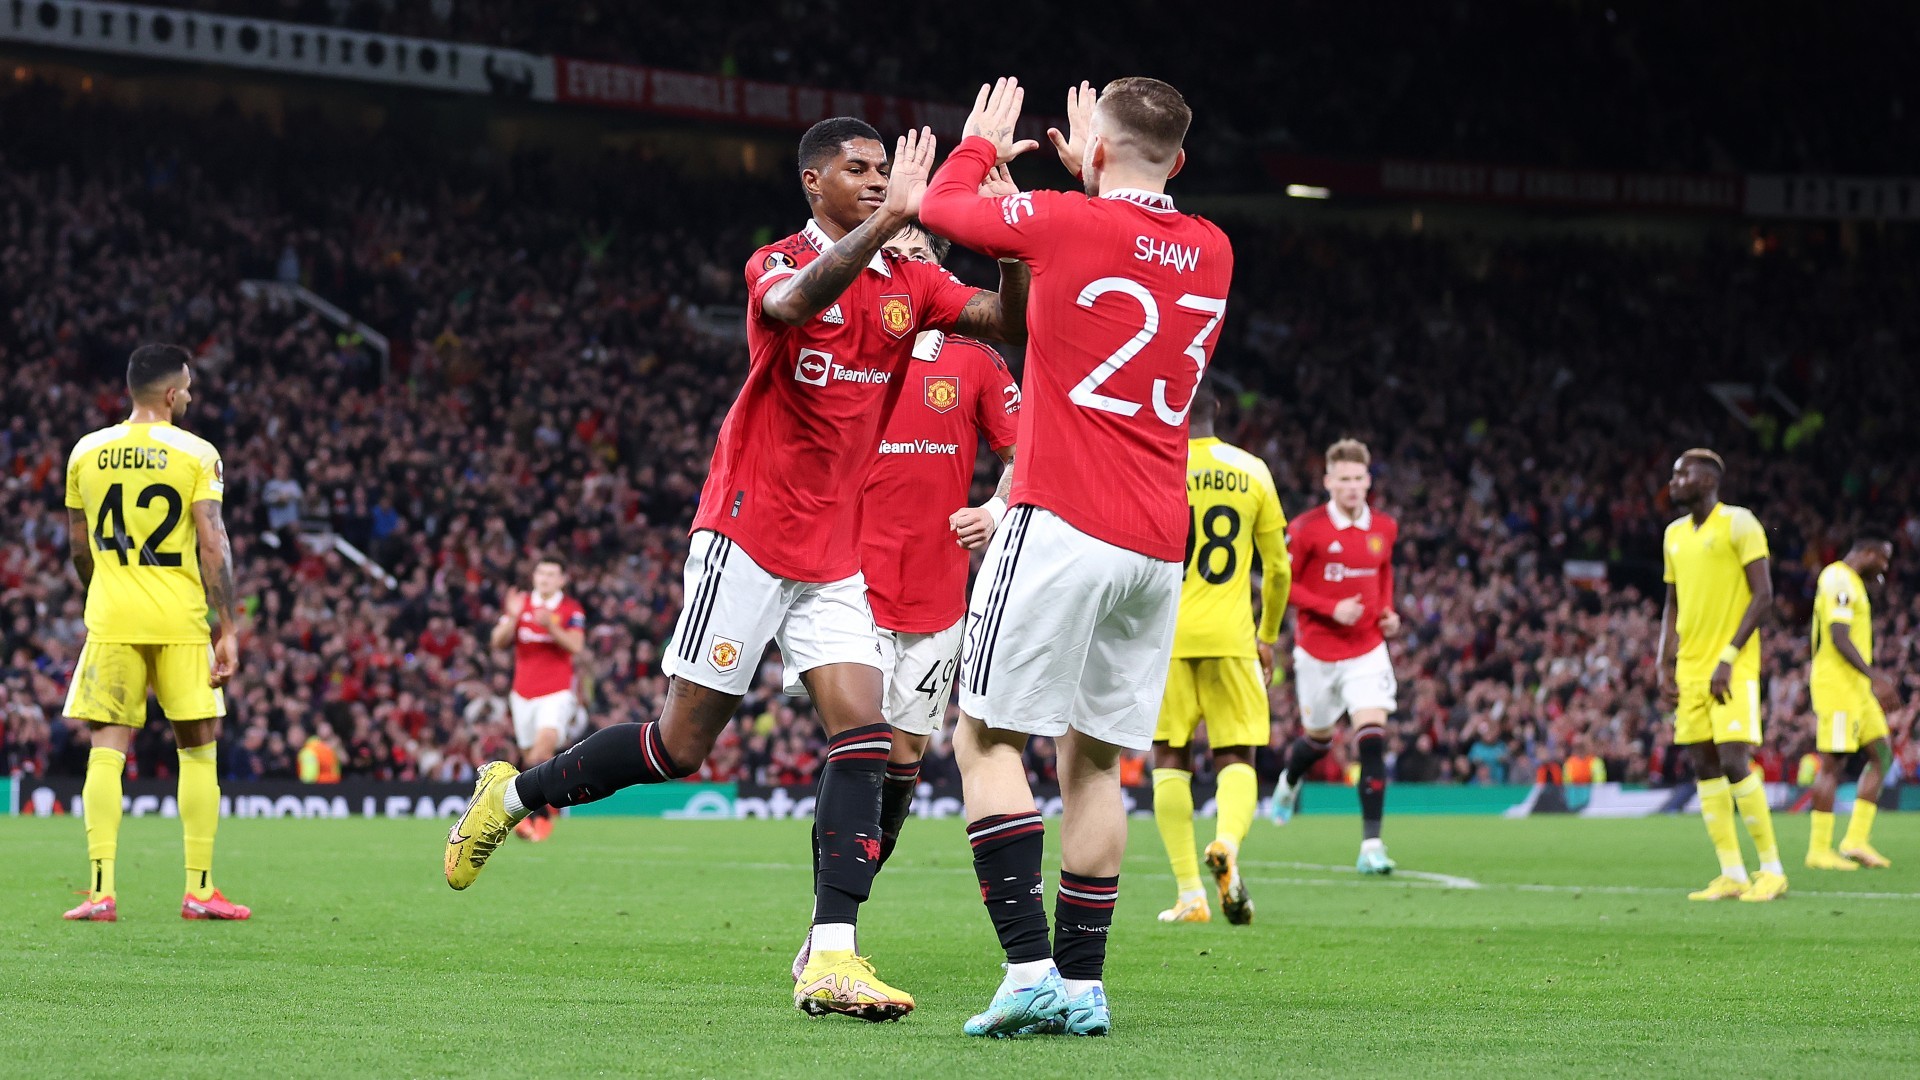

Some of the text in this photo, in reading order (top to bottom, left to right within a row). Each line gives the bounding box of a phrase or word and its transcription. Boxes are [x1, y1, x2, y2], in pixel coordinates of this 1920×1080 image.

[1134, 236, 1200, 274] SHAW
[822, 315, 845, 325] adidas
[1068, 276, 1226, 427] 23
[97, 447, 168, 470] GUEDES
[1186, 469, 1249, 494] YABOU
[94, 483, 183, 567] 42
